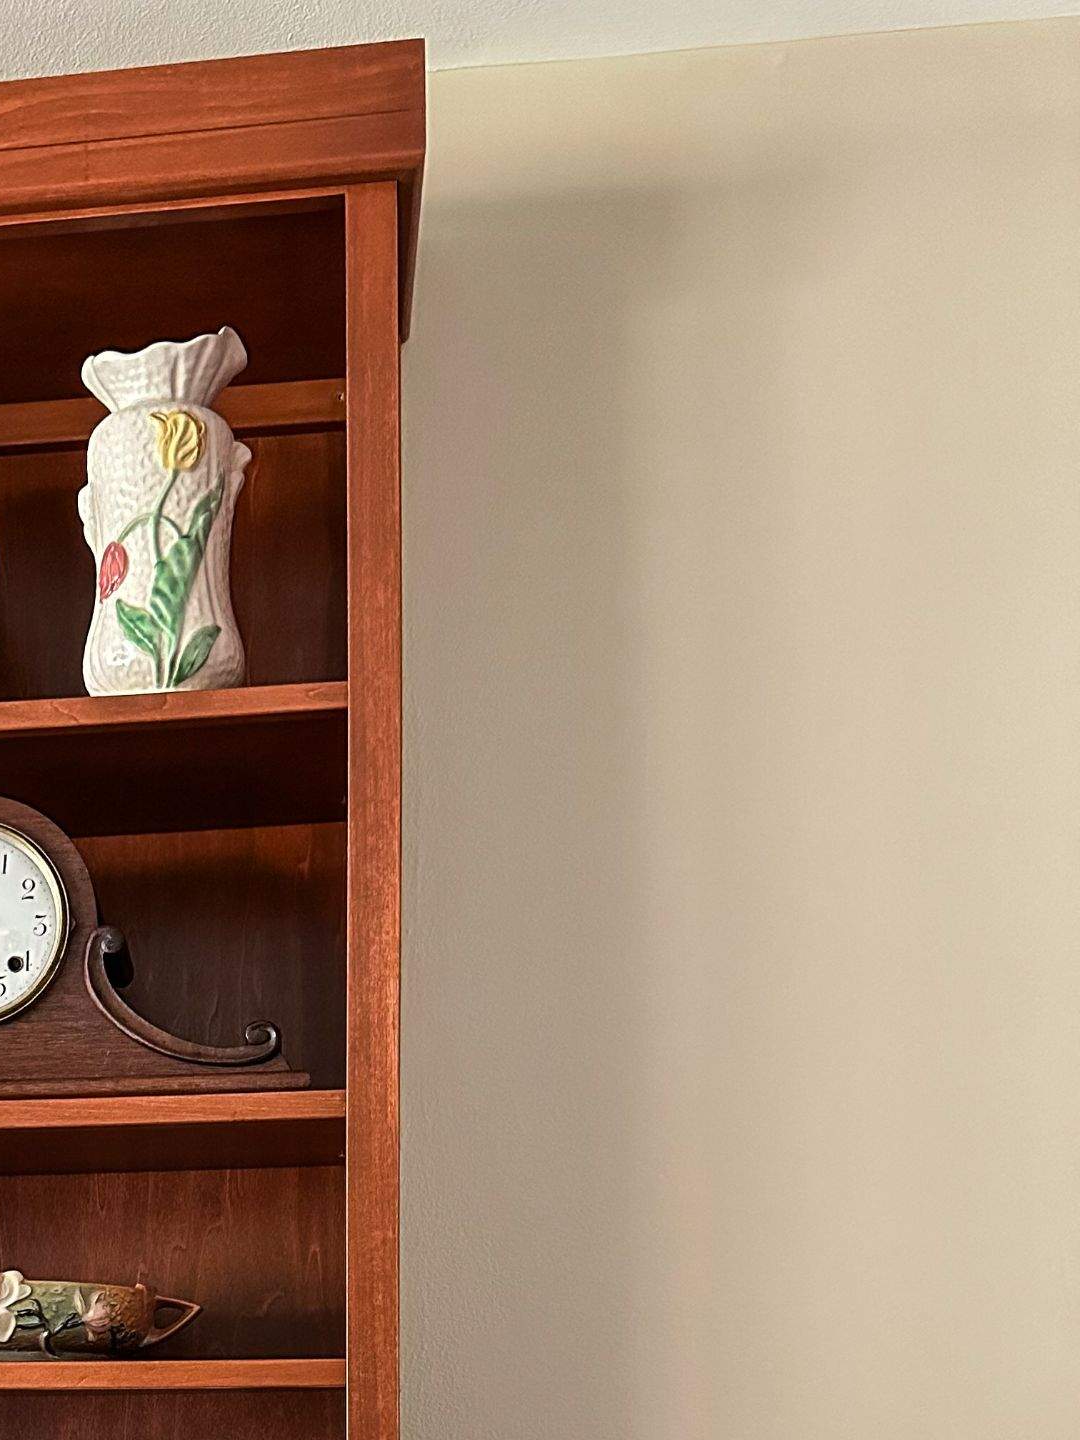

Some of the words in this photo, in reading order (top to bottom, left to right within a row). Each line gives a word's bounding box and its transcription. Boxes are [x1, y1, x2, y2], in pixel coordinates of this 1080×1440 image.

[2, 854, 8, 875] 1
[21, 879, 36, 900] 2
[33, 914, 48, 937] 3
